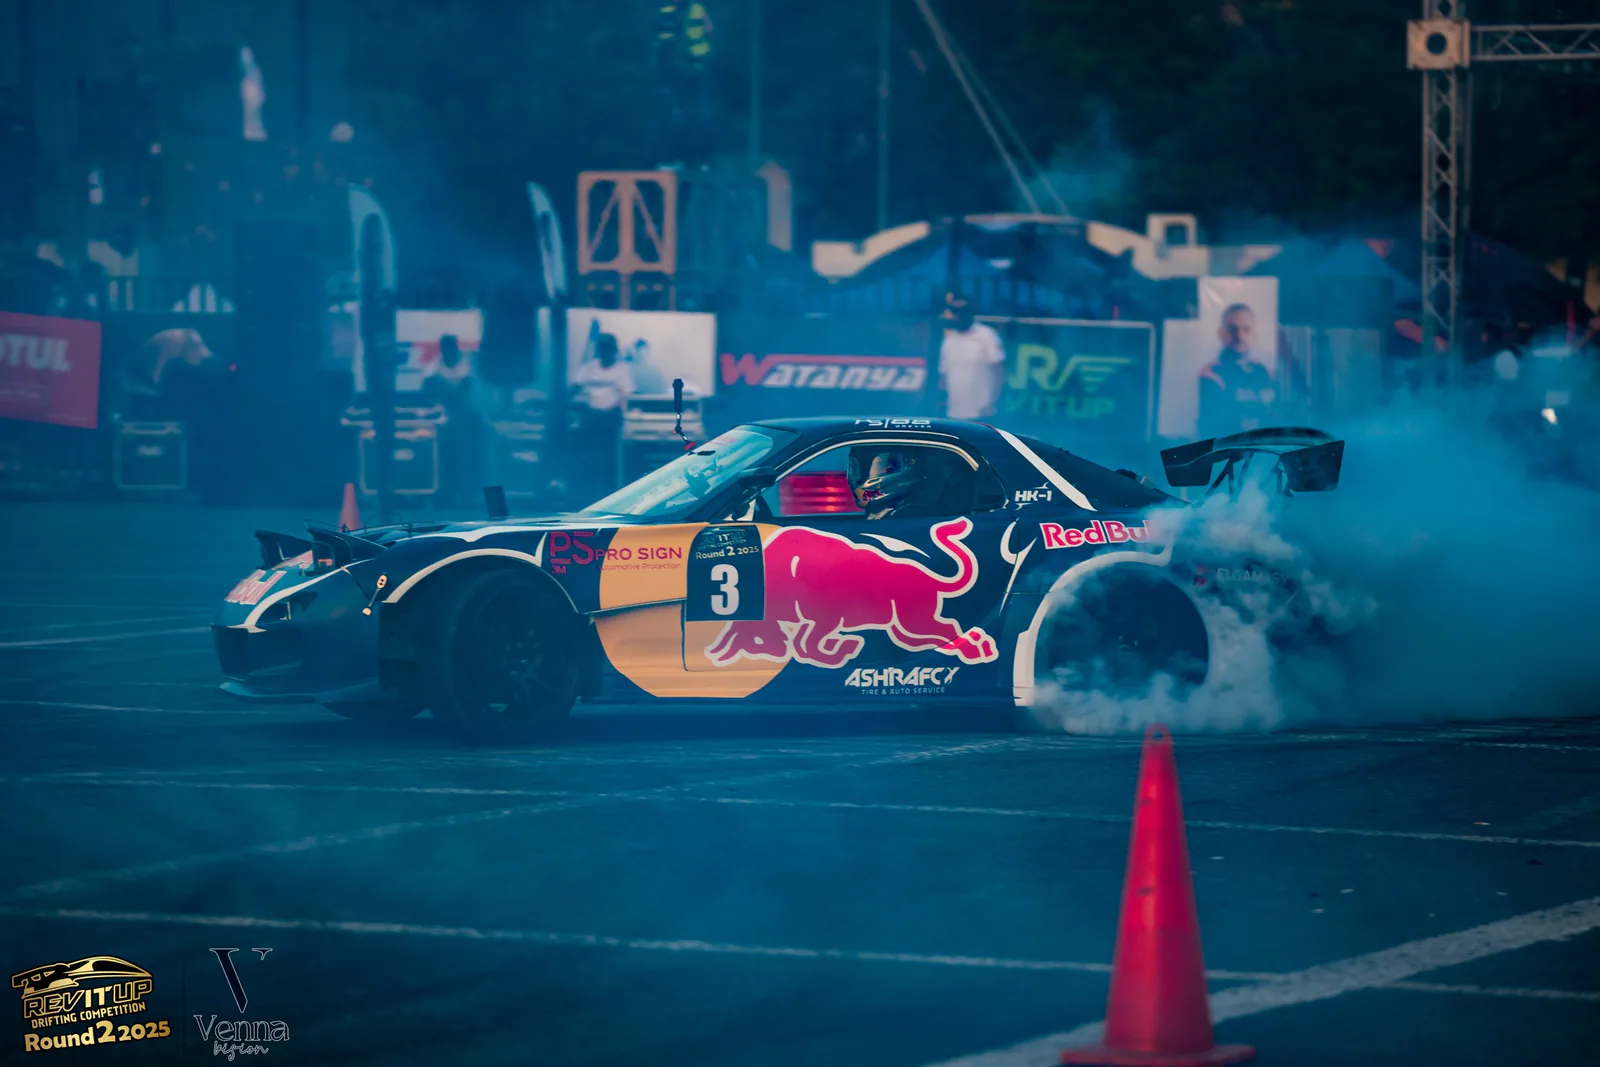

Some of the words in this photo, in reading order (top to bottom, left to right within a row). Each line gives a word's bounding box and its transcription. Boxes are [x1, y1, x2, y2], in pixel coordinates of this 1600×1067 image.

[1014, 490, 1053, 502] HK-1
[1039, 520, 1107, 549] Red
[595, 548, 632, 561] PRO
[638, 547, 682, 560] SIGN
[696, 549, 725, 560] Round
[726, 546, 735, 556] 2
[737, 546, 759, 555] 2025
[711, 564, 739, 615] 3
[890, 687, 911, 695] AUTO
